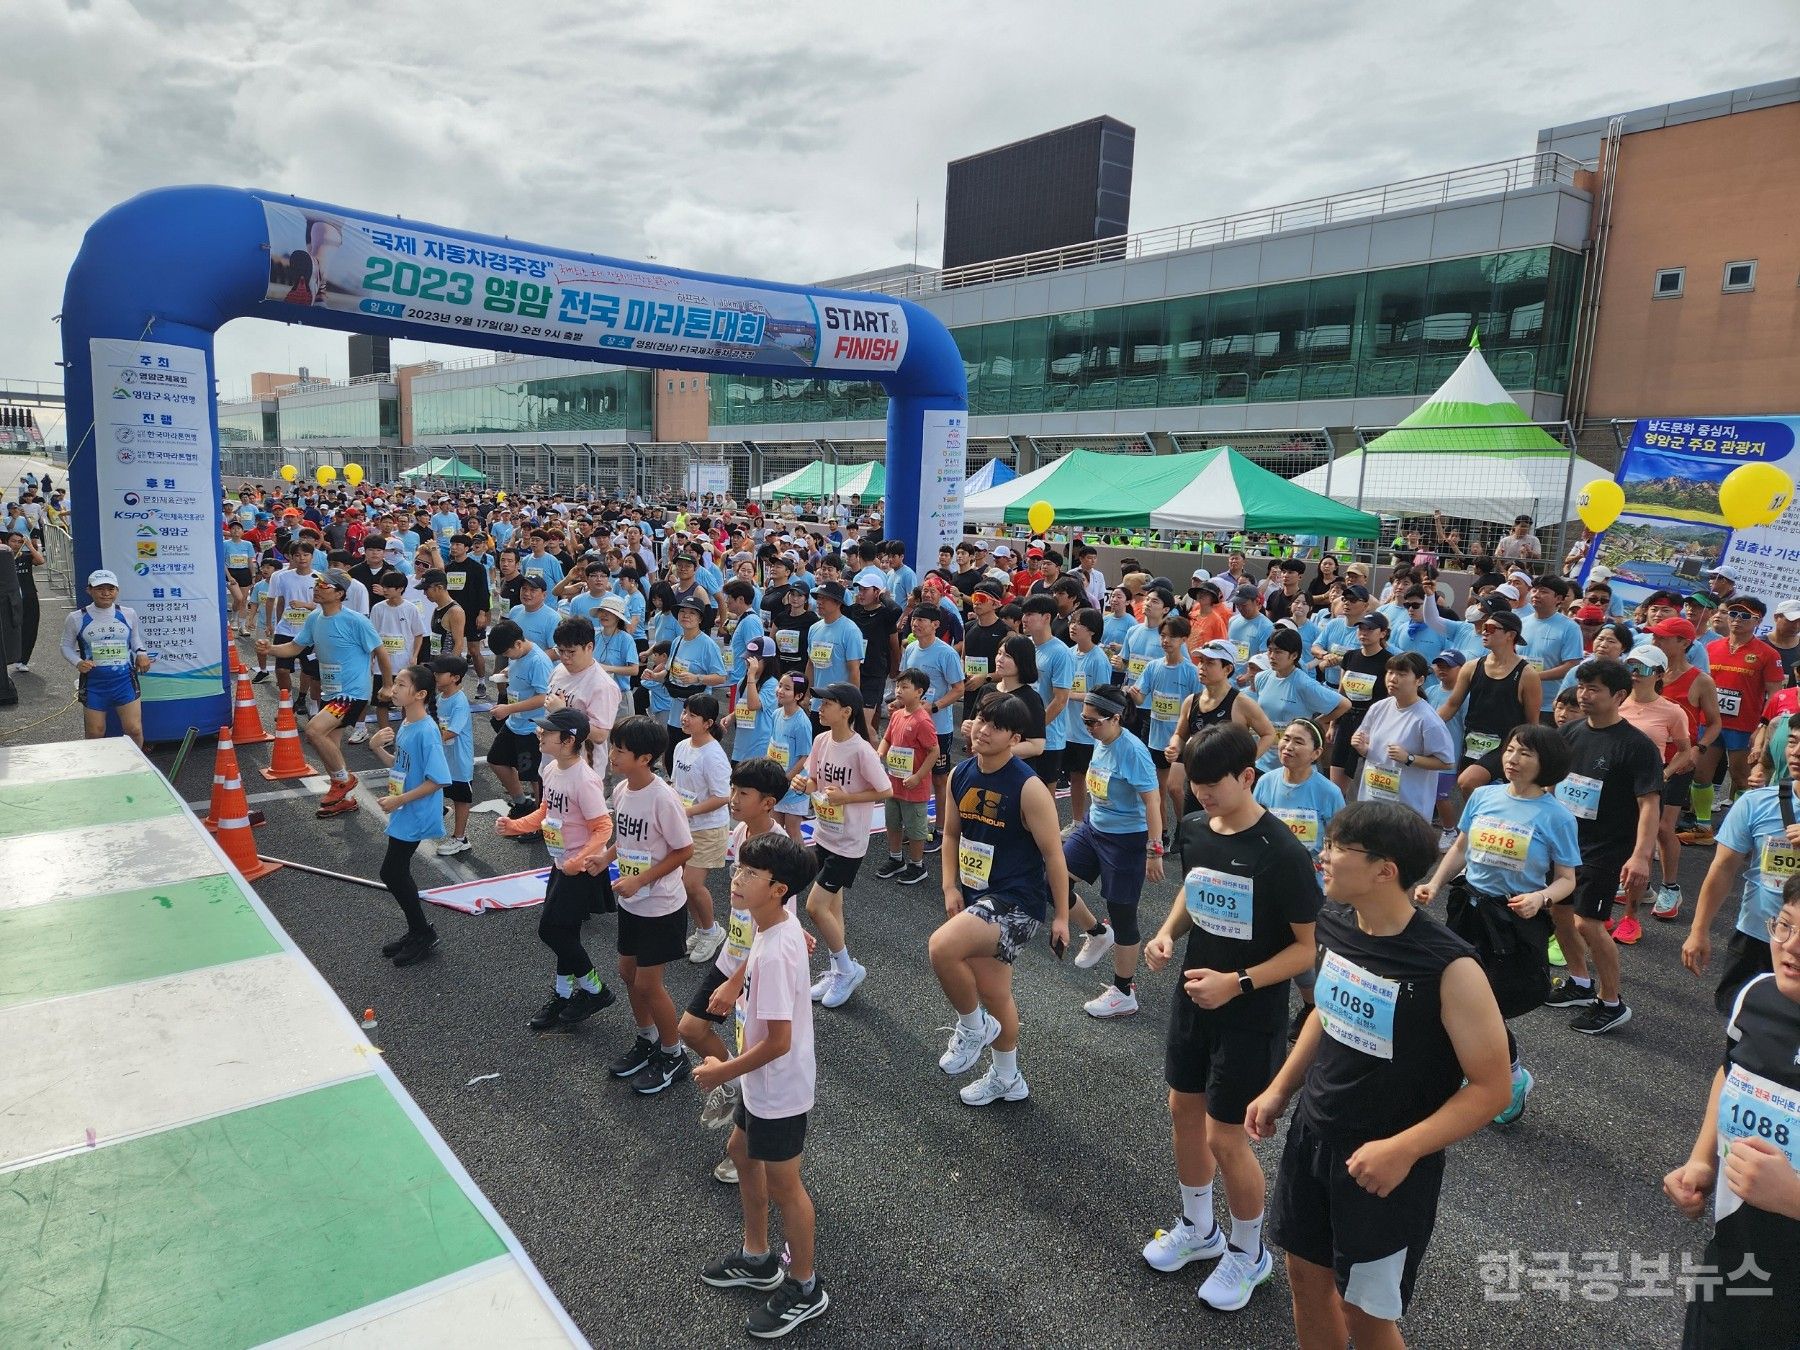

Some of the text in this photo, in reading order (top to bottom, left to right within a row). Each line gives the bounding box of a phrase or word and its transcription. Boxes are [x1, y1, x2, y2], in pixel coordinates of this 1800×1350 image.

[361, 228, 416, 255] "국제
[424, 238, 554, 277] 자동차경주장"
[362, 256, 767, 346] 2023 영암 전국 마라톤대회
[677, 293, 709, 305] 하프코스
[407, 308, 584, 342] 2023년 9월 17일(일) 오전 9시 출발
[825, 306, 900, 335] START &
[636, 339, 677, 355] 영암(전남)
[834, 336, 899, 362] FINISH
[139, 372, 188, 384] 영암군체육회
[147, 431, 198, 441] 한국마라톤연맹
[1647, 420, 1739, 439] 남도문화 중심지,
[1644, 432, 1766, 457] 영암군 주요 관광지
[143, 495, 197, 505] 문화체육관광부
[113, 511, 149, 520] KSPO
[159, 527, 190, 537] 영암군
[160, 544, 190, 552] 전라남도
[1735, 539, 1772, 557] 월출산
[150, 562, 195, 572] 전남개발공사
[146, 602, 189, 611] 영암경찰서
[138, 614, 198, 623] 영암교육지원청
[143, 626, 195, 636] 영암군소방서
[144, 639, 195, 648] 영암군보건소
[160, 652, 199, 661] 세한대학교
[824, 764, 853, 786] 덤벼!
[1369, 773, 1392, 785] 5820
[1563, 785, 1589, 800] 1297
[617, 812, 649, 842] 덤벼!
[1480, 832, 1515, 849] 5818
[1198, 889, 1237, 911] 1093
[1350, 972, 1361, 984] 전국
[1361, 979, 1378, 994] 마라톤
[1378, 988, 1393, 1001] 대회
[1330, 985, 1375, 1019] 1089
[1330, 1022, 1377, 1051] 현대삼호중공업
[1728, 1075, 1741, 1088] 2023
[1740, 1081, 1755, 1095] 영암
[1755, 1087, 1772, 1102] 전국
[1771, 1094, 1796, 1112] 마라톤
[1731, 1103, 1789, 1146] 1088
